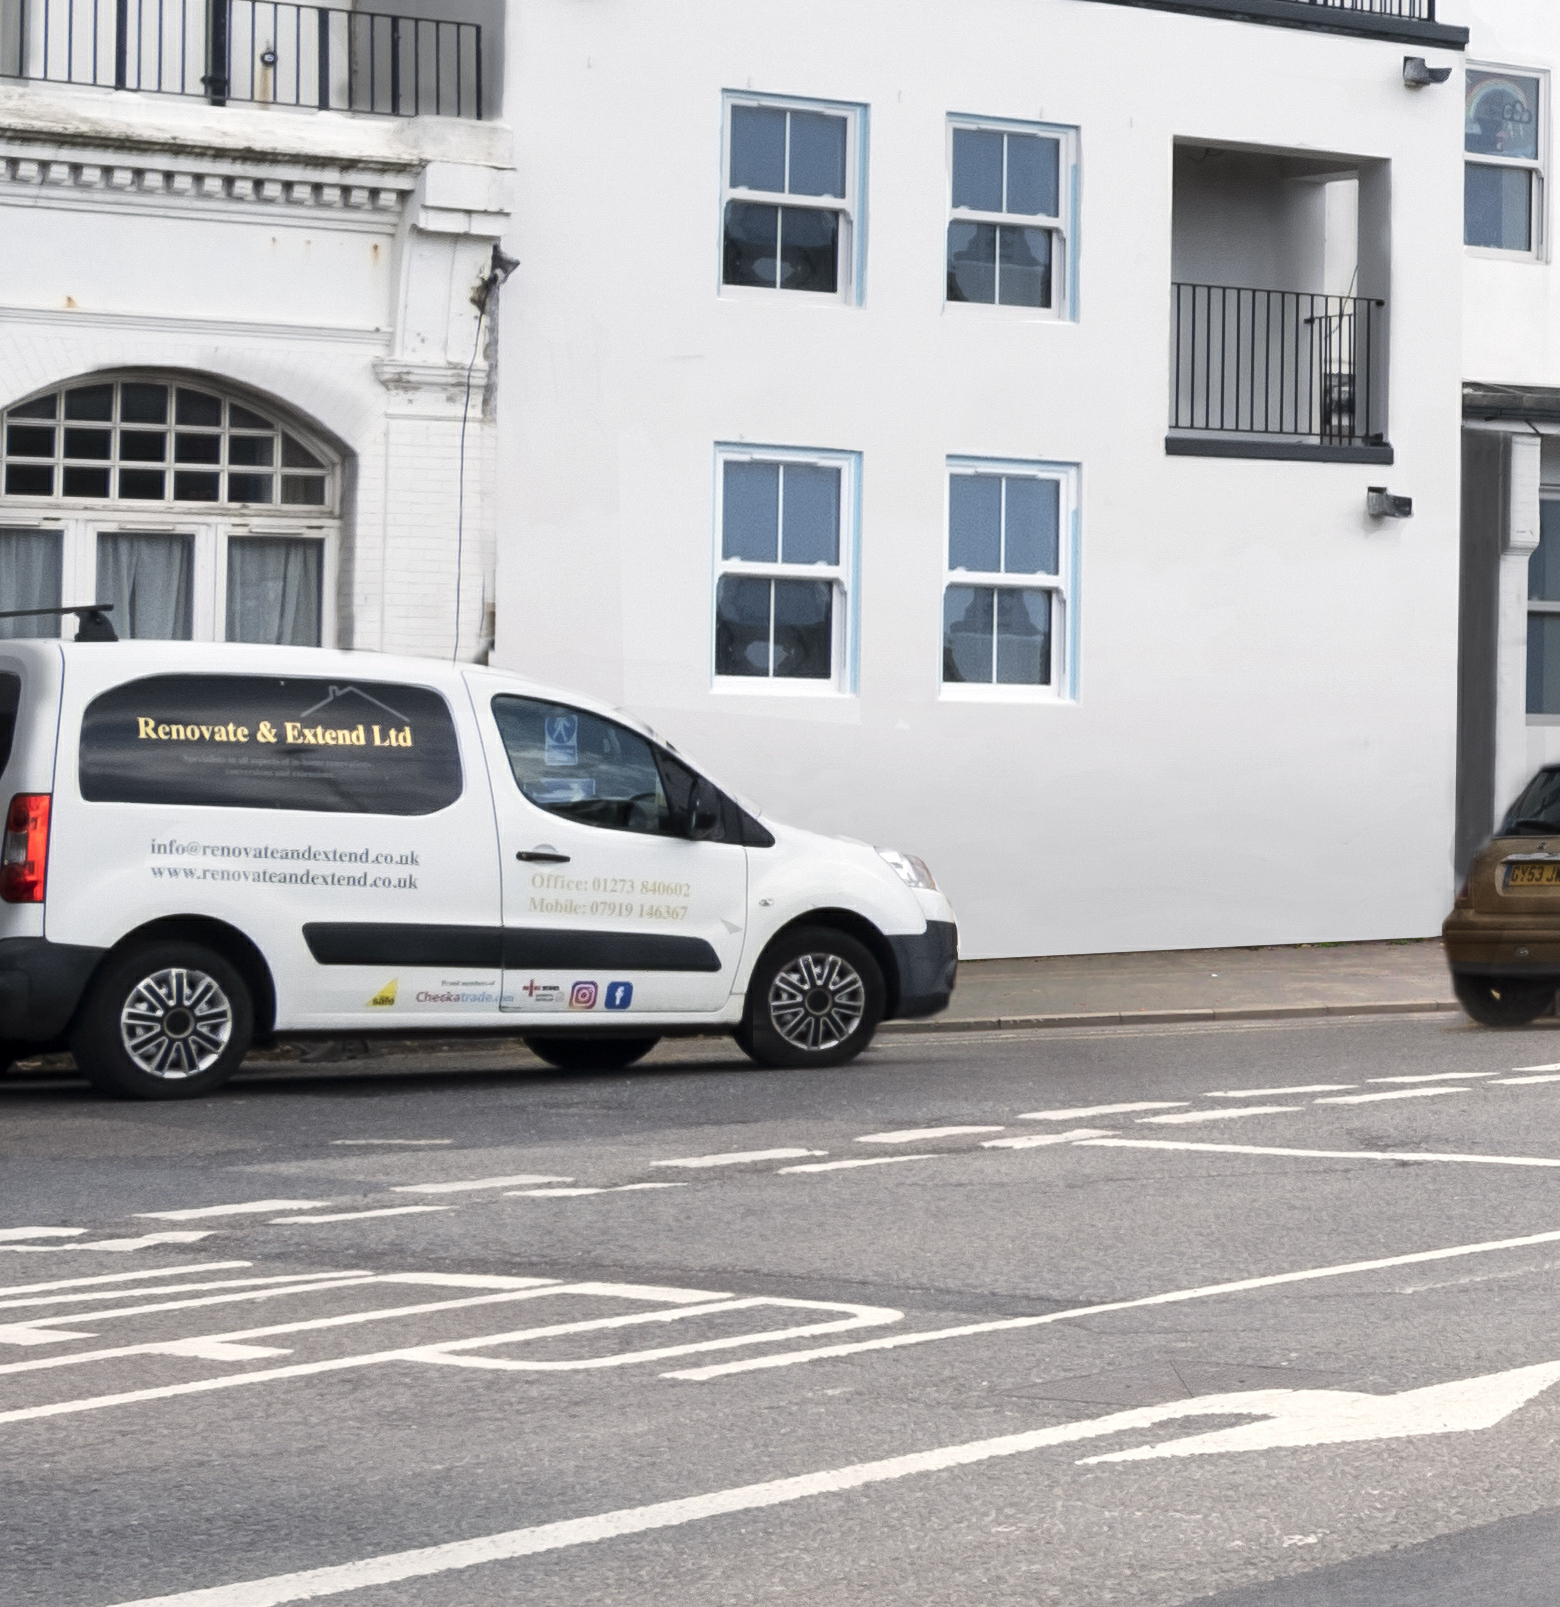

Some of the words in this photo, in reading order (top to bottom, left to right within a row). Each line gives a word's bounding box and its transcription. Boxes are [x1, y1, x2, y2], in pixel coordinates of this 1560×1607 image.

[137, 716, 250, 743] Renovate
[256, 720, 278, 743] &
[284, 721, 367, 746] Extend
[371, 724, 413, 747] Ltd
[150, 838, 421, 866] info@renovateandextend.co.uk
[150, 866, 418, 890] www.renovateandextend.co.uk
[530, 873, 589, 892] Office:
[592, 877, 635, 894] 01273
[528, 897, 587, 915] Mobile:
[590, 901, 634, 917] 07919
